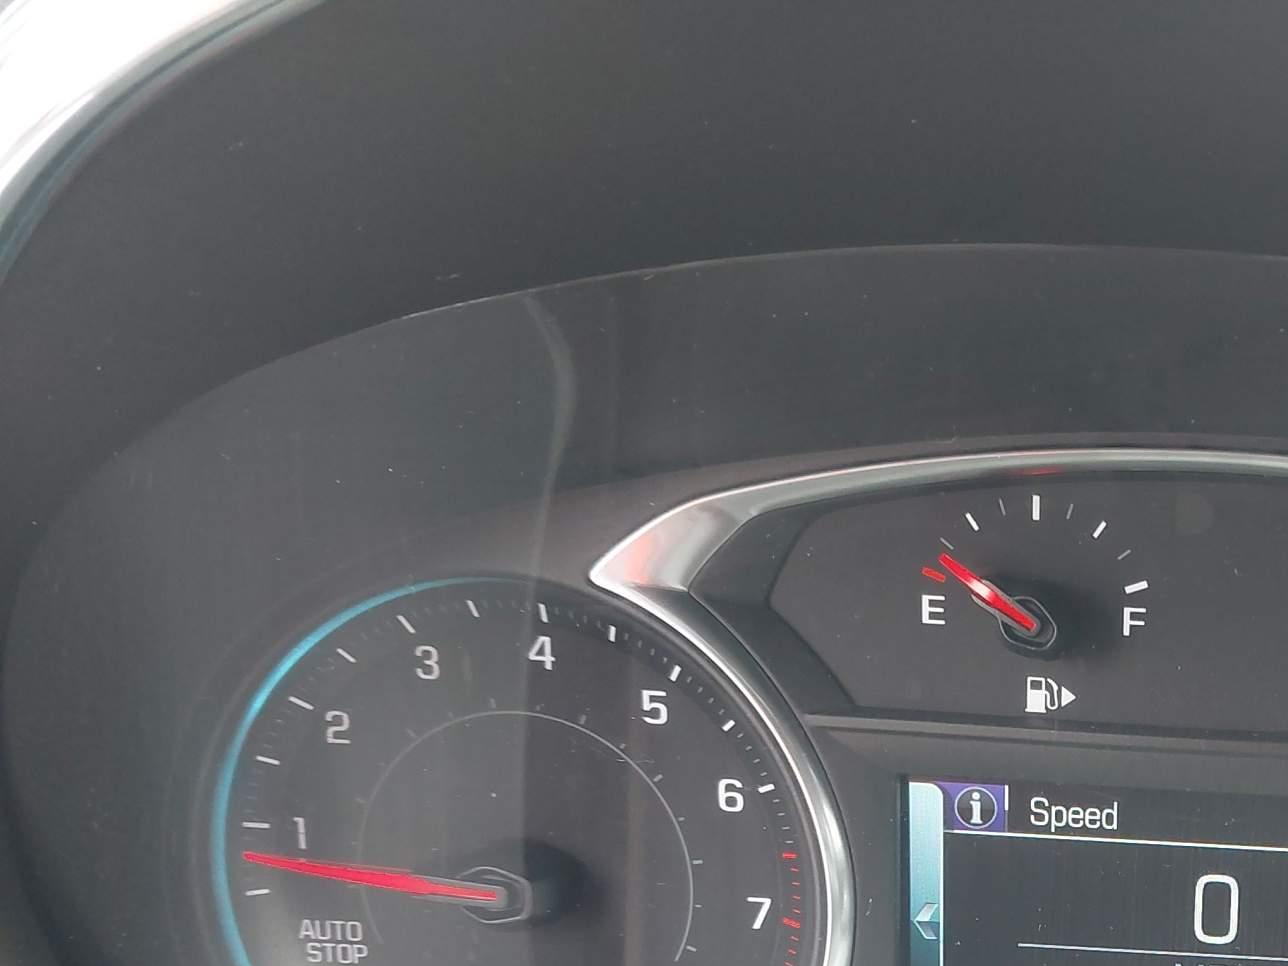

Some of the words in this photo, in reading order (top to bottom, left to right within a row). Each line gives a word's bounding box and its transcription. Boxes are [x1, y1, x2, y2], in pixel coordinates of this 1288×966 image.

[921, 595, 945, 625] E
[1122, 607, 1147, 636] F
[415, 646, 440, 680] 3
[528, 636, 556, 670] 4
[641, 690, 668, 725] 5
[325, 711, 351, 745] 2
[718, 778, 744, 812] 6
[1030, 797, 1118, 832] Speed
[294, 817, 307, 849] 1
[747, 897, 772, 930] 7
[1193, 874, 1239, 944] 0
[300, 920, 363, 942] AUTO
[307, 944, 368, 965] STOP
